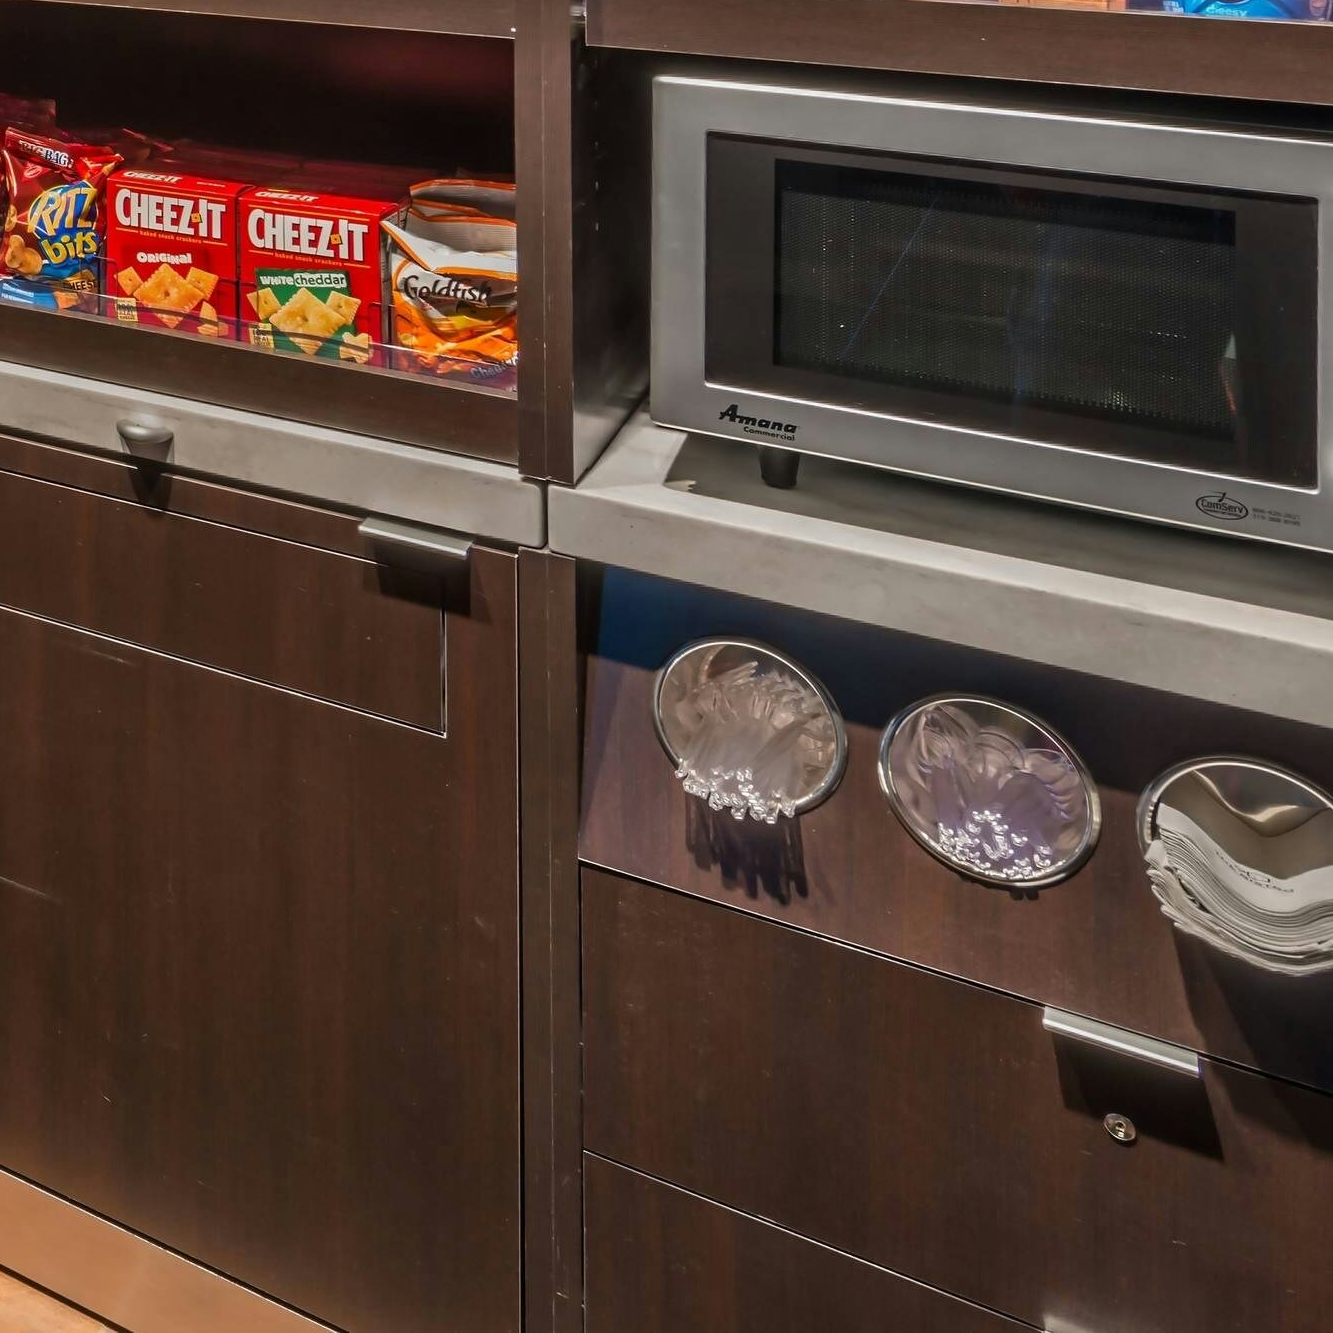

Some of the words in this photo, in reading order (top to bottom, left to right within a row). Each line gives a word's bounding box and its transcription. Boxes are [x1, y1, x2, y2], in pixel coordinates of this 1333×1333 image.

[28, 188, 98, 237] RITZ
[40, 232, 98, 264] bits
[294, 273, 345, 288] cheddar
[719, 404, 797, 433] Amana
[744, 426, 795, 441] Commercial
[1201, 499, 1243, 513] ComServ
